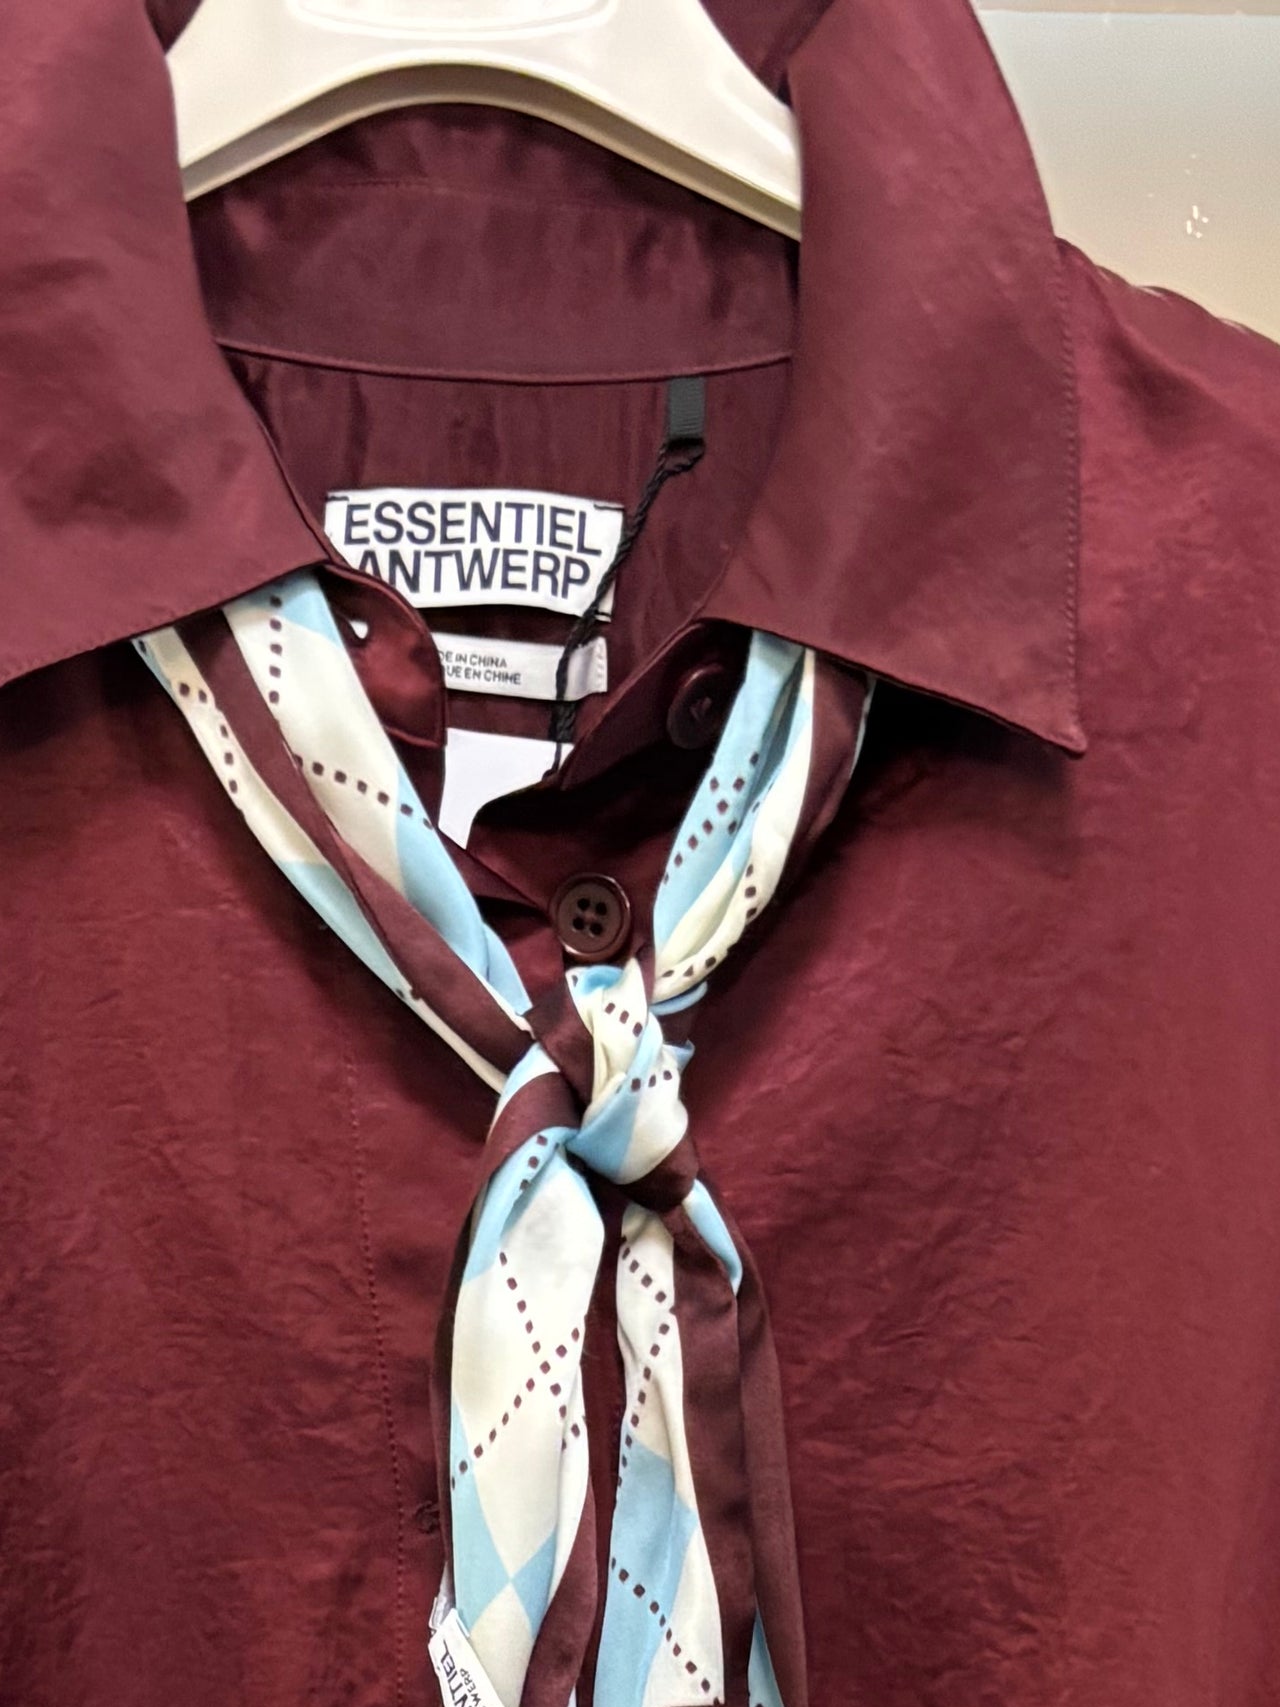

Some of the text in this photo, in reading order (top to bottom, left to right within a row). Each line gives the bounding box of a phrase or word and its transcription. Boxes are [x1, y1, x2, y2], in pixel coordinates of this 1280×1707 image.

[344, 500, 602, 556] ESSENTIEL
[455, 652, 467, 665] IN
[469, 653, 507, 668] CHINA
[464, 666, 481, 680] EN
